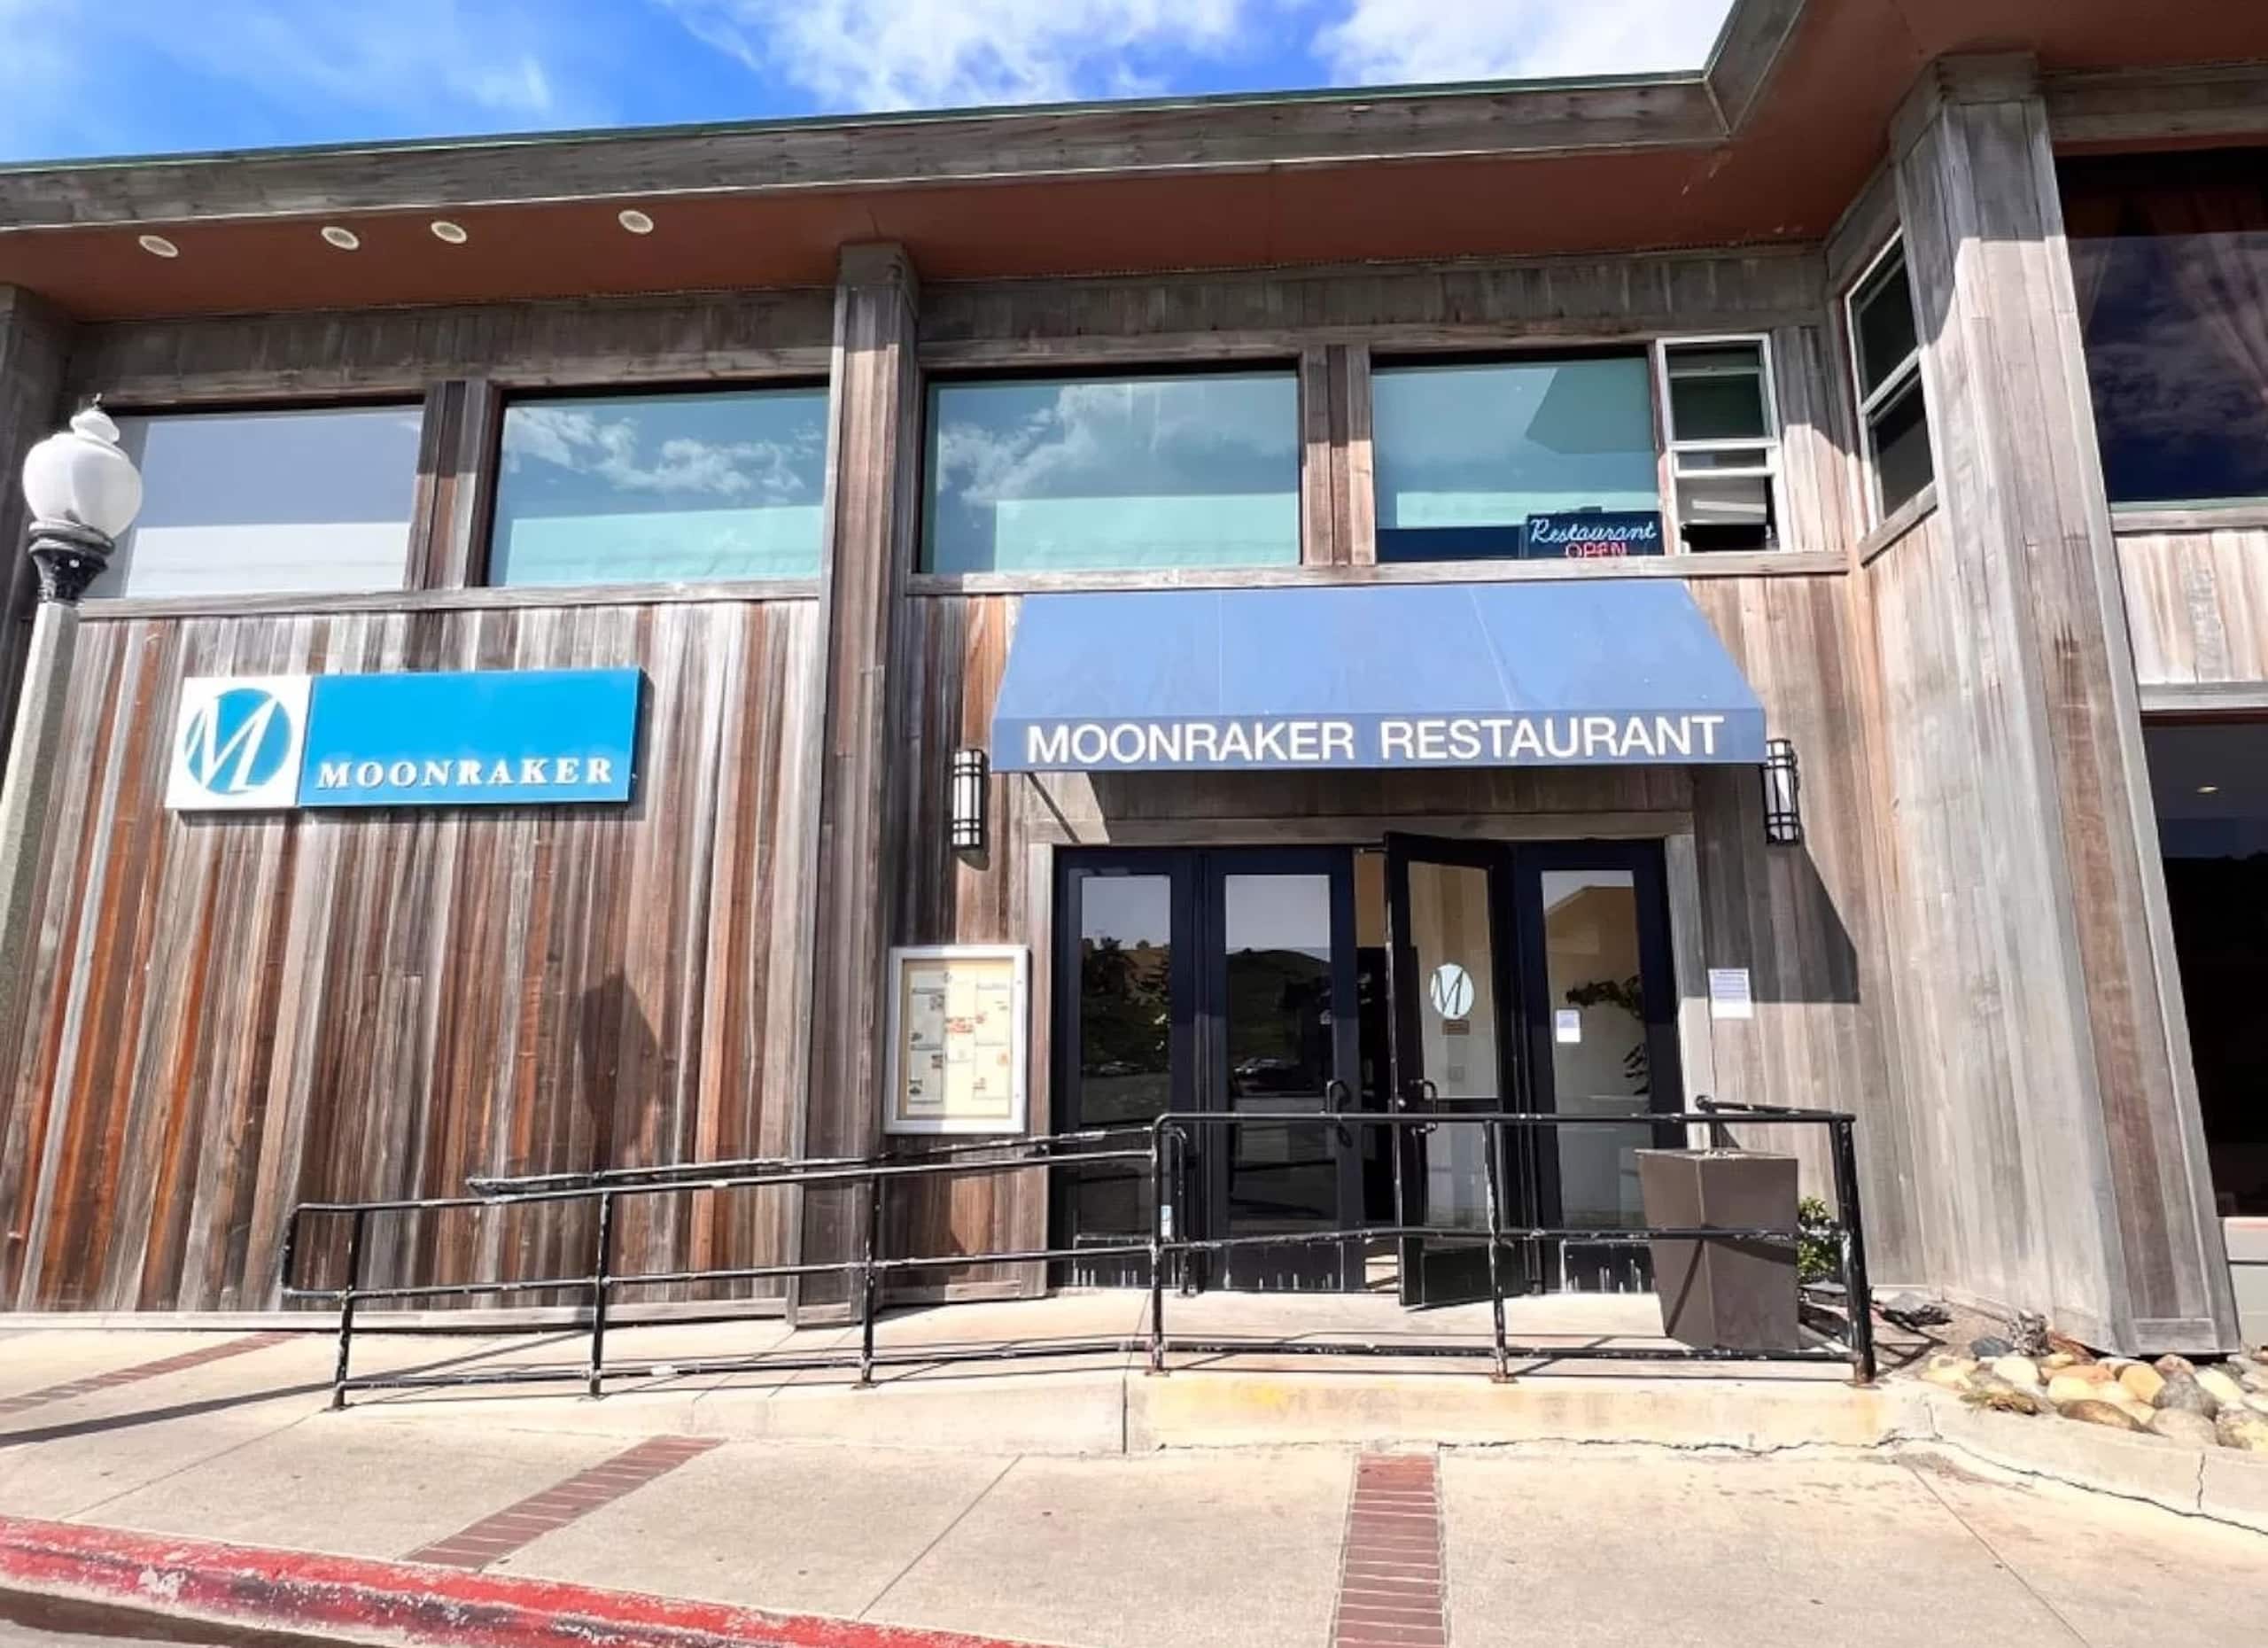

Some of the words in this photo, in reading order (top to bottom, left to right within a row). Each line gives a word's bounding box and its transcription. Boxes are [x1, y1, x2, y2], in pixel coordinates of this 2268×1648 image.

[1530, 518, 1657, 542] Restaurant
[1565, 542, 1627, 558] OPEN
[185, 696, 279, 792] M
[1027, 721, 1355, 764] MOONRAKER
[1380, 715, 1725, 760] RESTAURANT
[317, 758, 612, 789] MOONRAKER
